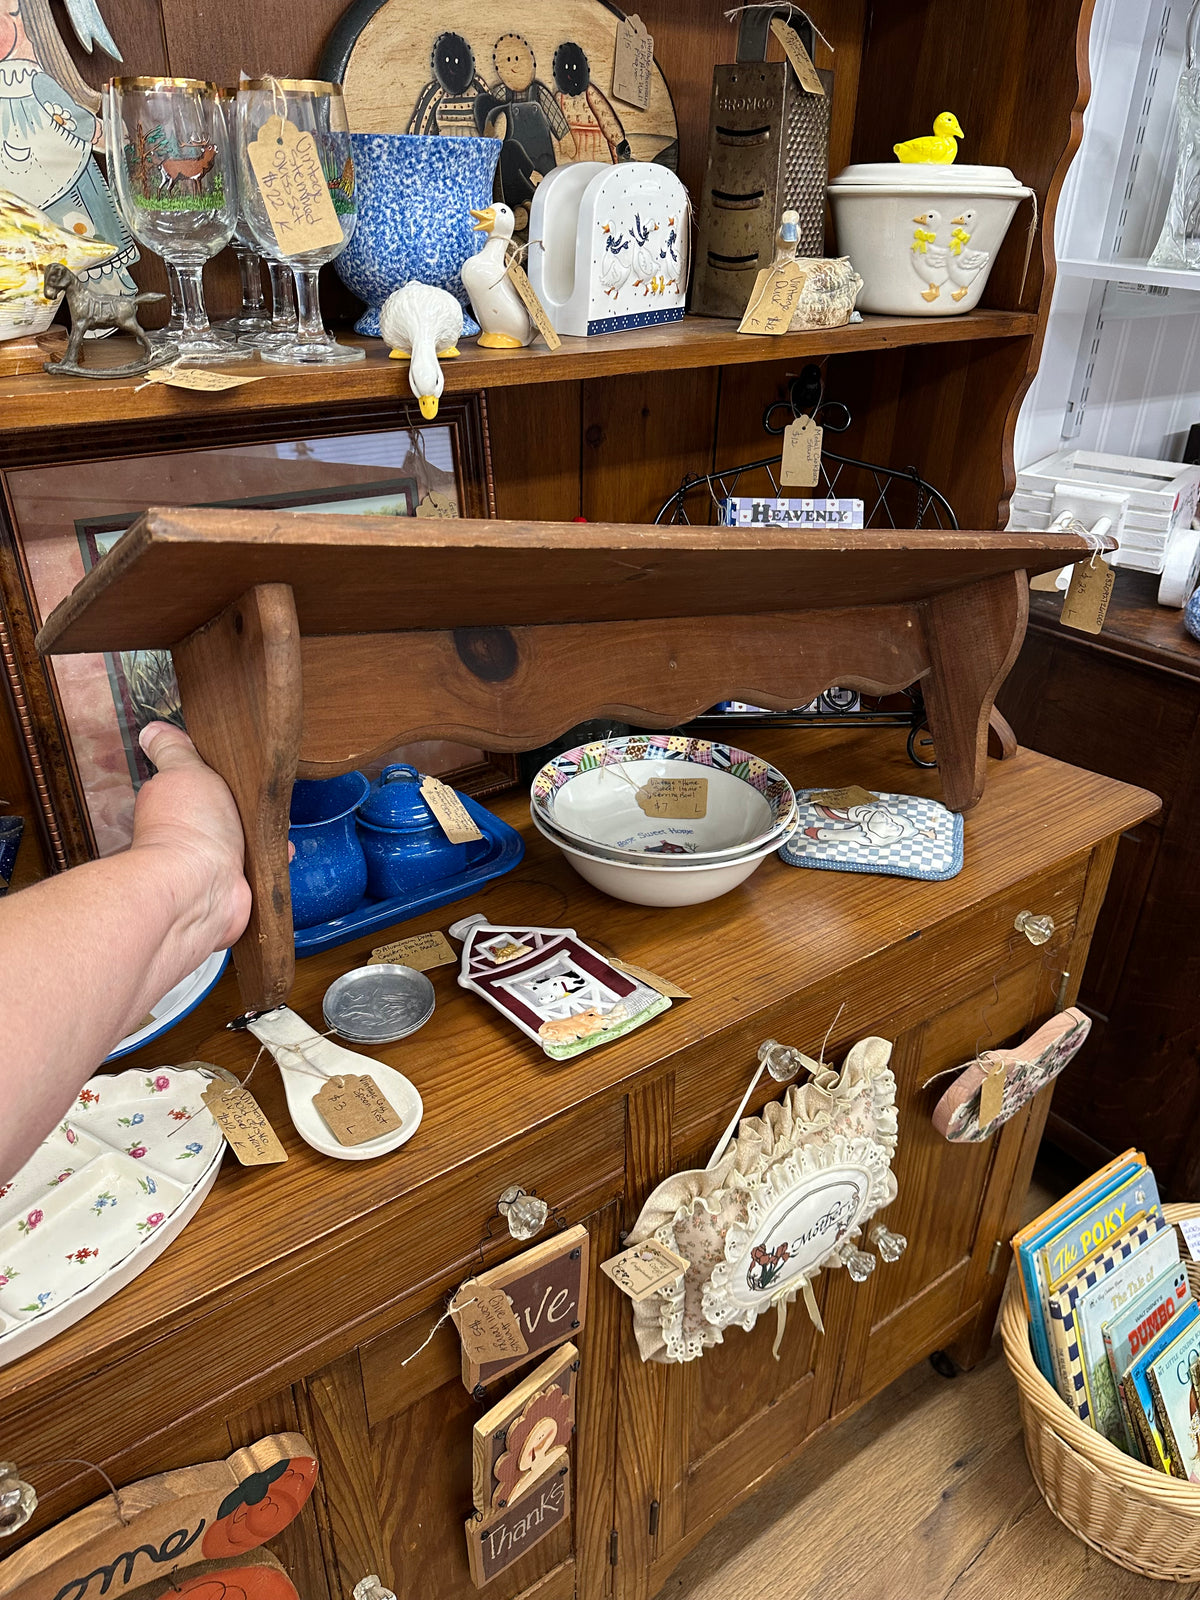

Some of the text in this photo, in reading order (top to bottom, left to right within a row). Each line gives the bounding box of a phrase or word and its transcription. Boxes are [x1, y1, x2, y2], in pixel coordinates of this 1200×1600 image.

[618, 83, 627, 92] L
[719, 98, 775, 111] BROMCO
[295, 135, 323, 205] Vintage
[262, 171, 293, 234] $22 K
[771, 280, 789, 304] Duck
[780, 275, 804, 312] Vintage
[785, 430, 803, 478] $12 L
[806, 439, 815, 462] Stand
[814, 428, 822, 451] Metal
[751, 503, 848, 523] HEAVENLY
[1068, 609, 1077, 619] L
[655, 799, 702, 813] $7 L
[637, 829, 668, 839] Sweet
[667, 827, 695, 836] Home
[360, 1075, 378, 1100] Vintage
[240, 1091, 267, 1129] Vintage
[353, 1087, 390, 1125] Spoon Rest
[216, 1112, 247, 1150] $12 K
[221, 1096, 266, 1156] divided tray
[346, 1124, 356, 1135] L
[1053, 1202, 1127, 1275] The POKY
[1111, 1266, 1155, 1310] The Tale of
[477, 1300, 496, 1324] wall
[488, 1294, 506, 1320] Give
[469, 1319, 487, 1353] $5 K
[1128, 1296, 1176, 1356] DUMBO
[1165, 1353, 1179, 1370] LITTLE
[1179, 1338, 1195, 1355] GOLDEN
